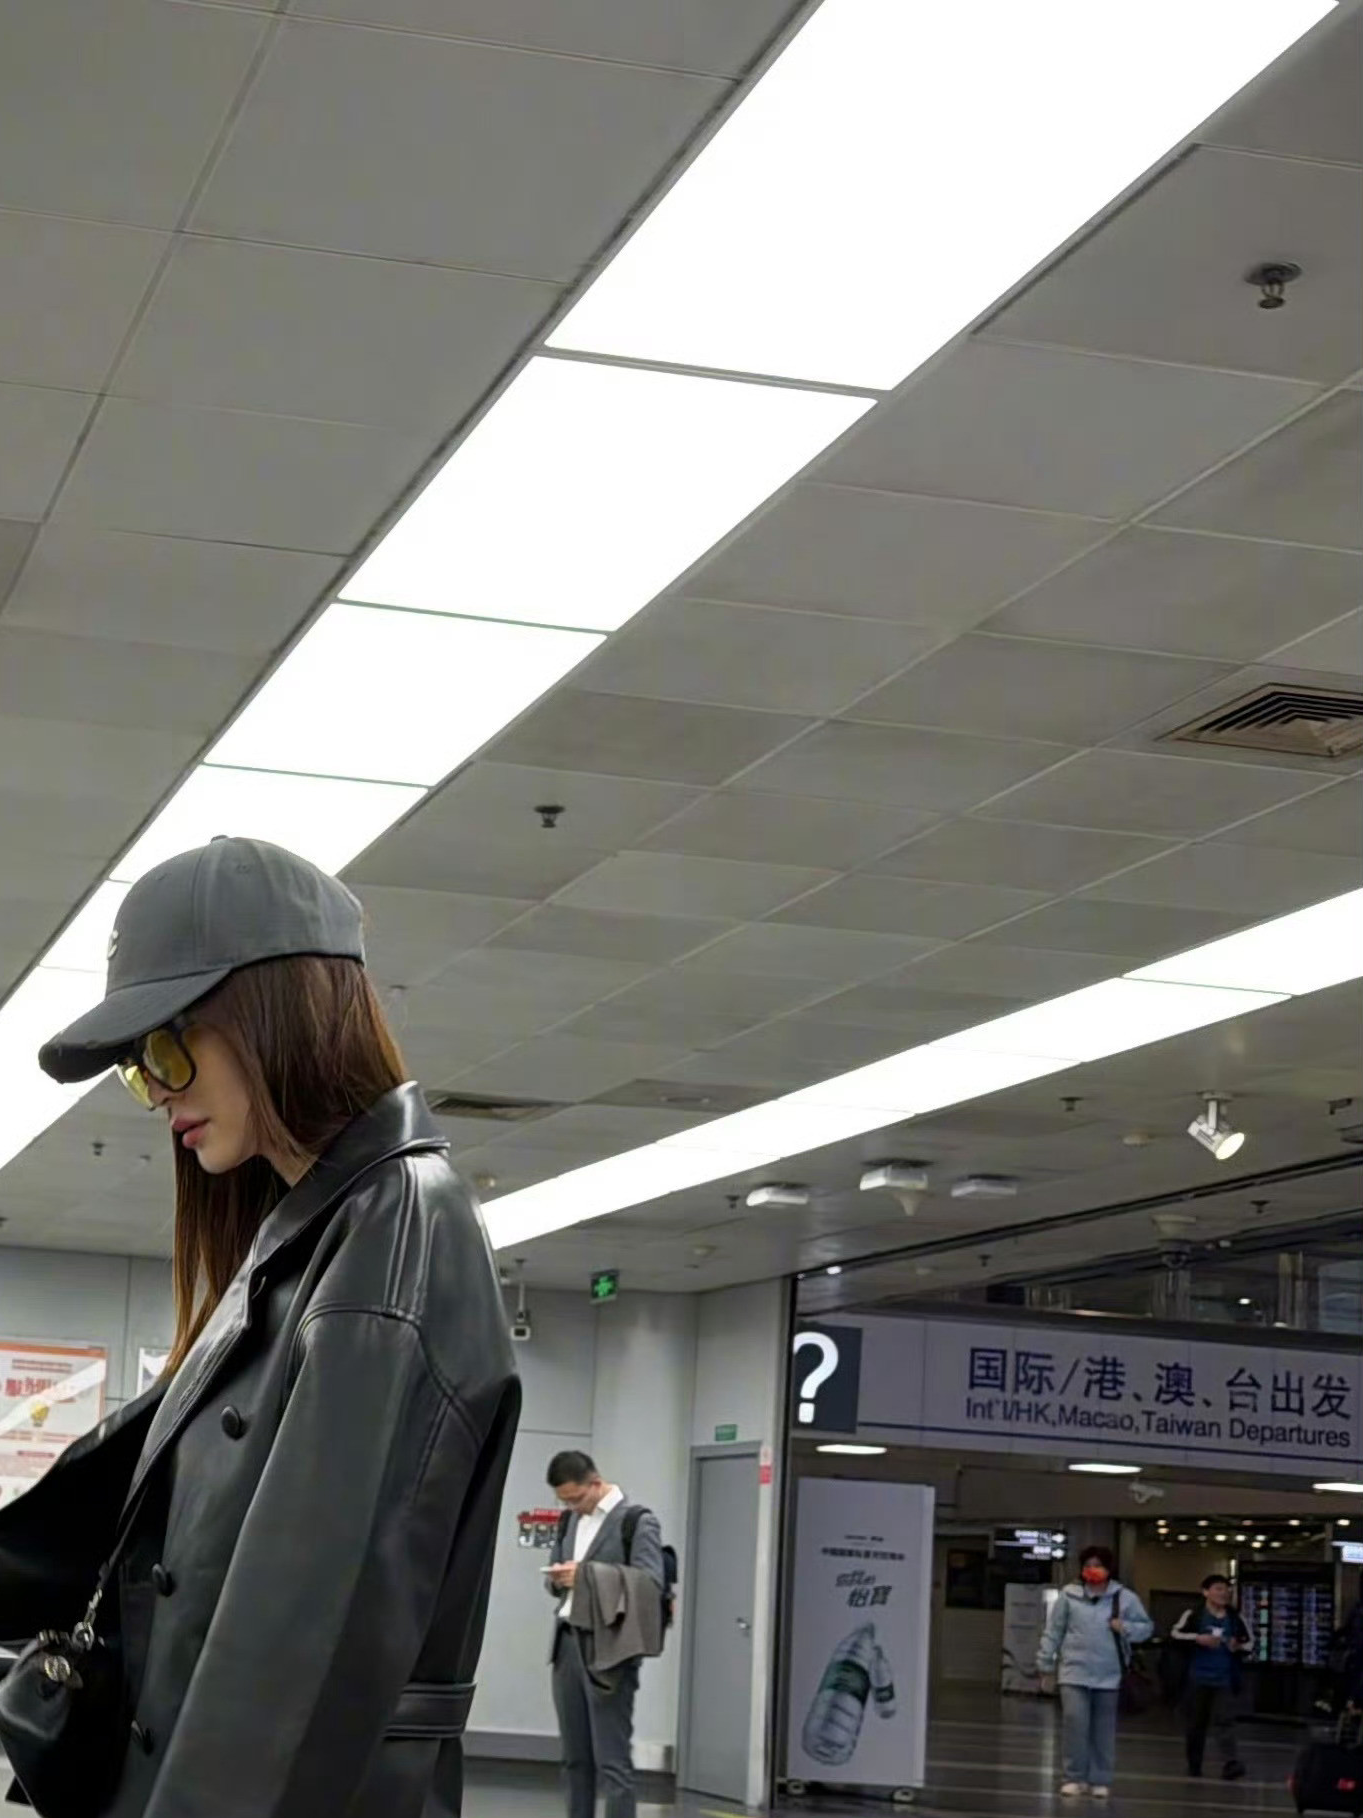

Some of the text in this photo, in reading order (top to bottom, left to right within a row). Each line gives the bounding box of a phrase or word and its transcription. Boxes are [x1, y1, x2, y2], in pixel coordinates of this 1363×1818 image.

[968, 1346, 1352, 1421] 国际/港、澳、台出发
[1228, 1417, 1352, 1448] Departures
